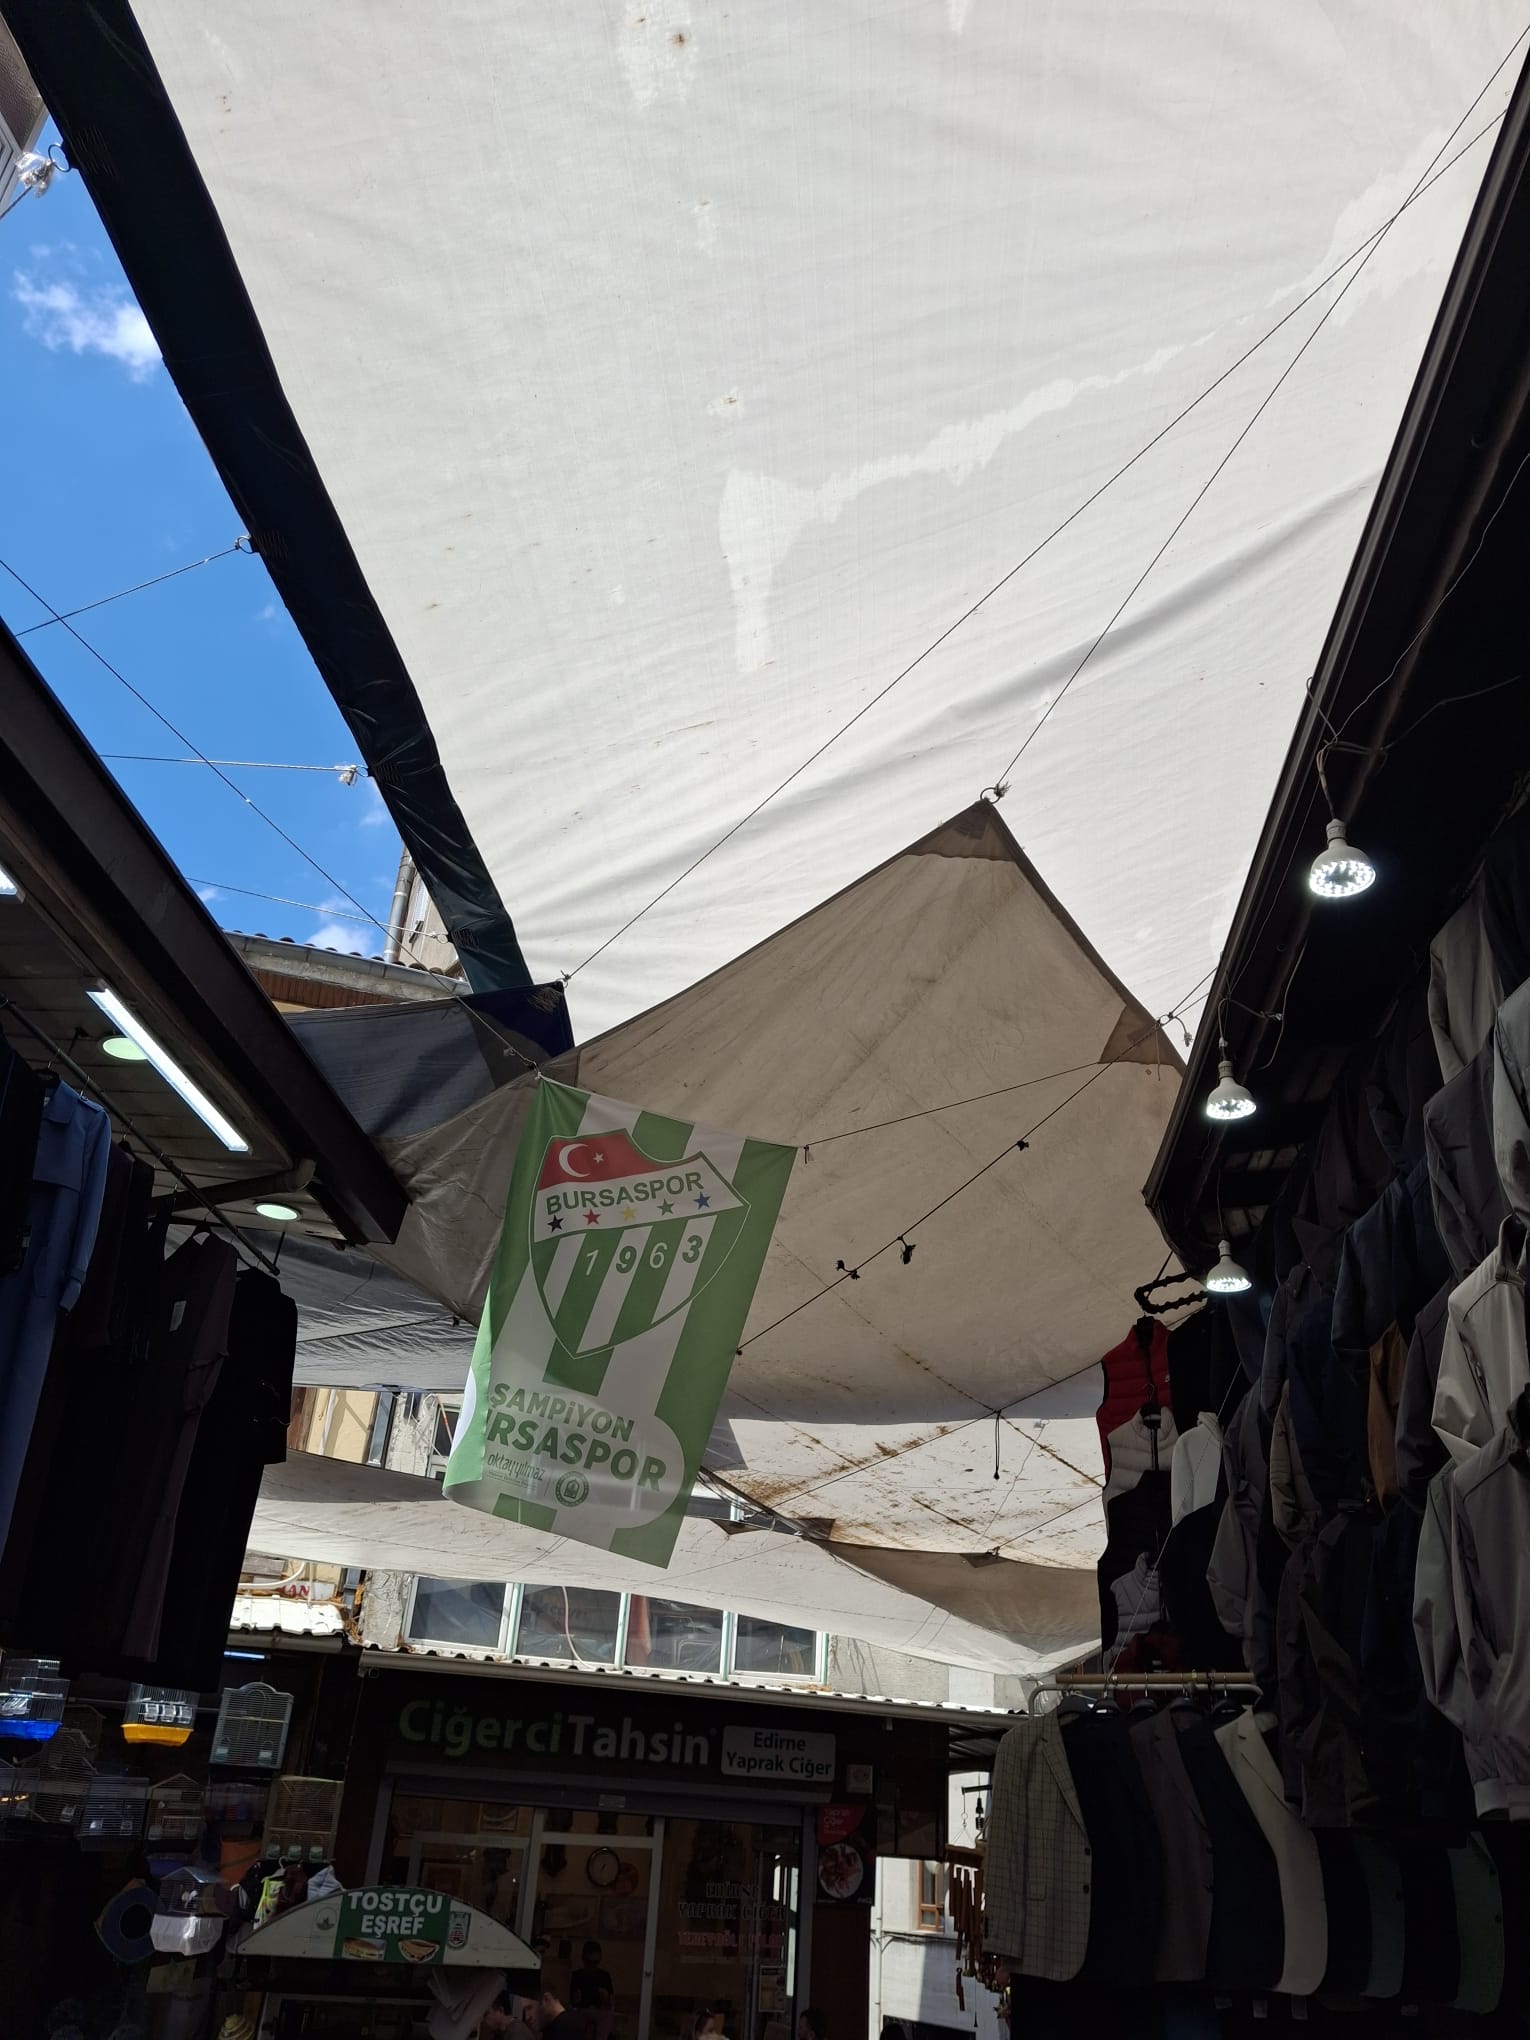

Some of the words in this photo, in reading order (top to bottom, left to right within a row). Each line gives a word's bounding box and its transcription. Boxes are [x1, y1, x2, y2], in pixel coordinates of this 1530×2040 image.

[546, 1172, 704, 1216] BURSASPOR
[585, 1234, 703, 1276] 1963
[487, 1409, 667, 1491] RSASPOR
[567, 1713, 709, 1766] Tahsin
[754, 1732, 806, 1752] Edirne
[727, 1751, 784, 1773] Yaprak
[789, 1756, 833, 1778] Ciğer
[348, 1891, 443, 1918] TOSTÇU
[361, 1914, 424, 1938] EŞREF
